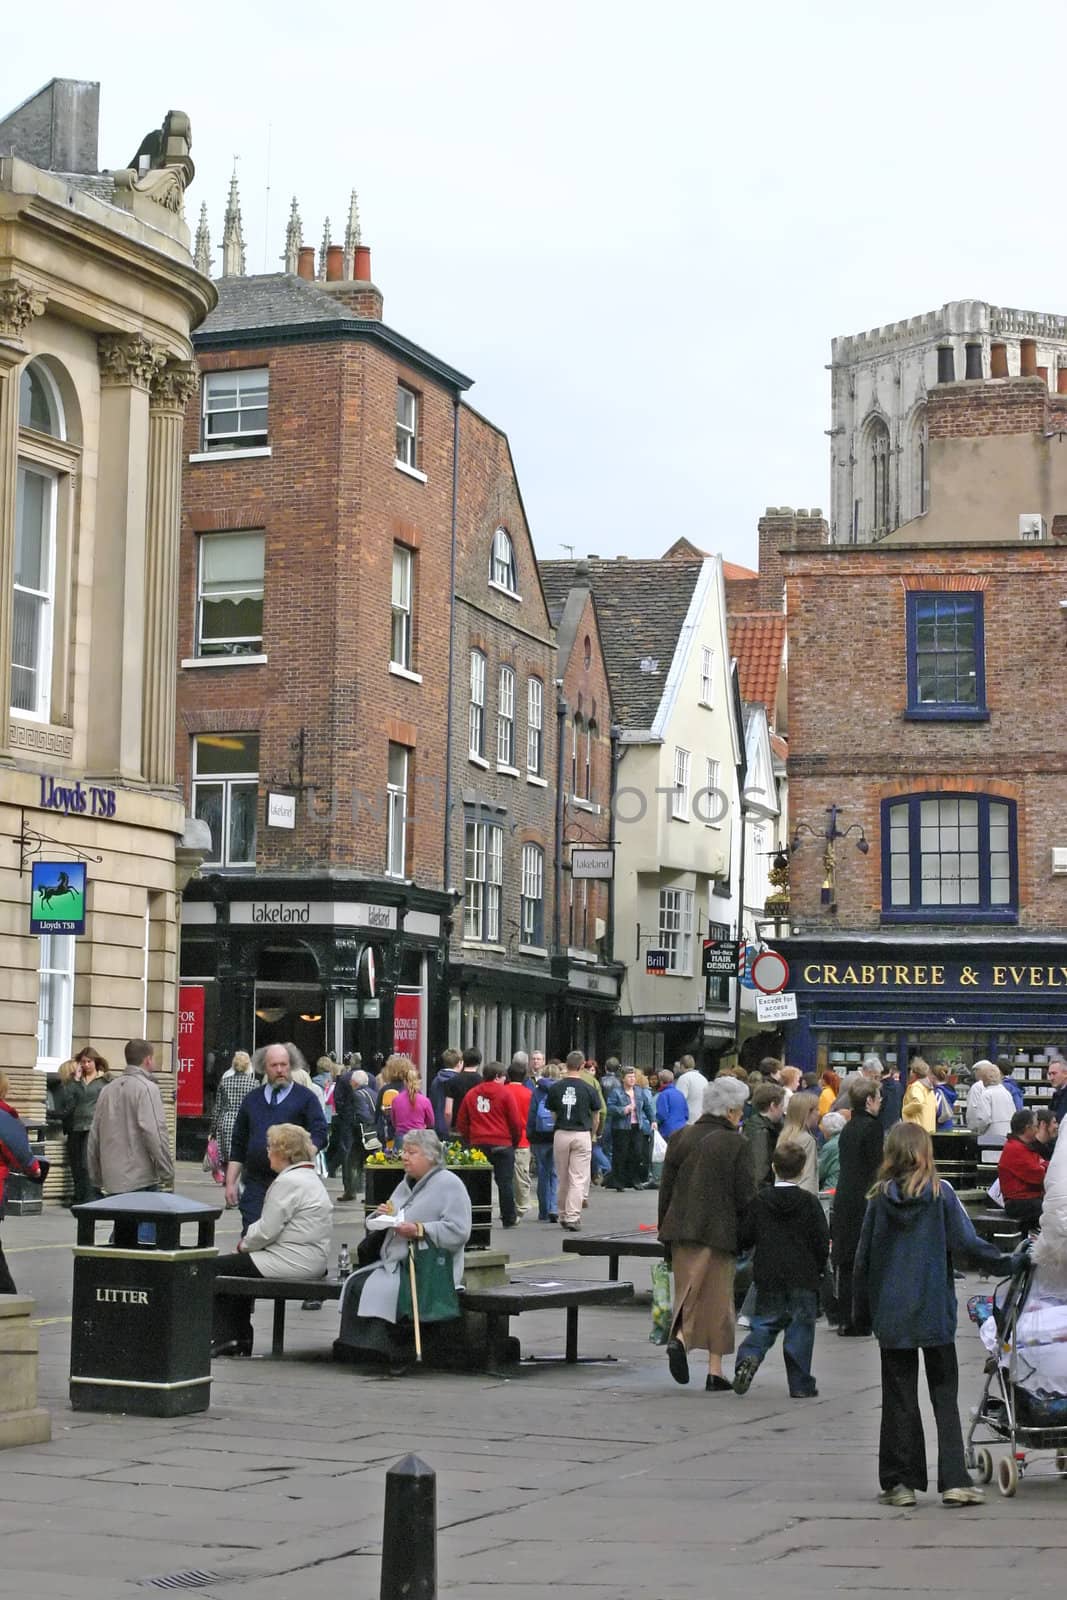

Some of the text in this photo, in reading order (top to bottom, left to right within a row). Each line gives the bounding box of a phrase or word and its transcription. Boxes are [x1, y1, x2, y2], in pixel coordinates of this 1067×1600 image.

[40, 775, 116, 817] Lloyds TSB
[270, 803, 293, 818] lakeland
[576, 858, 609, 869] lakeland
[252, 903, 310, 923] lakeland
[39, 921, 75, 931] Lloyds TSB
[647, 955, 664, 967] Brill
[803, 964, 945, 985] CRABTREE
[959, 966, 980, 985] &
[96, 1288, 149, 1304] LITTER
